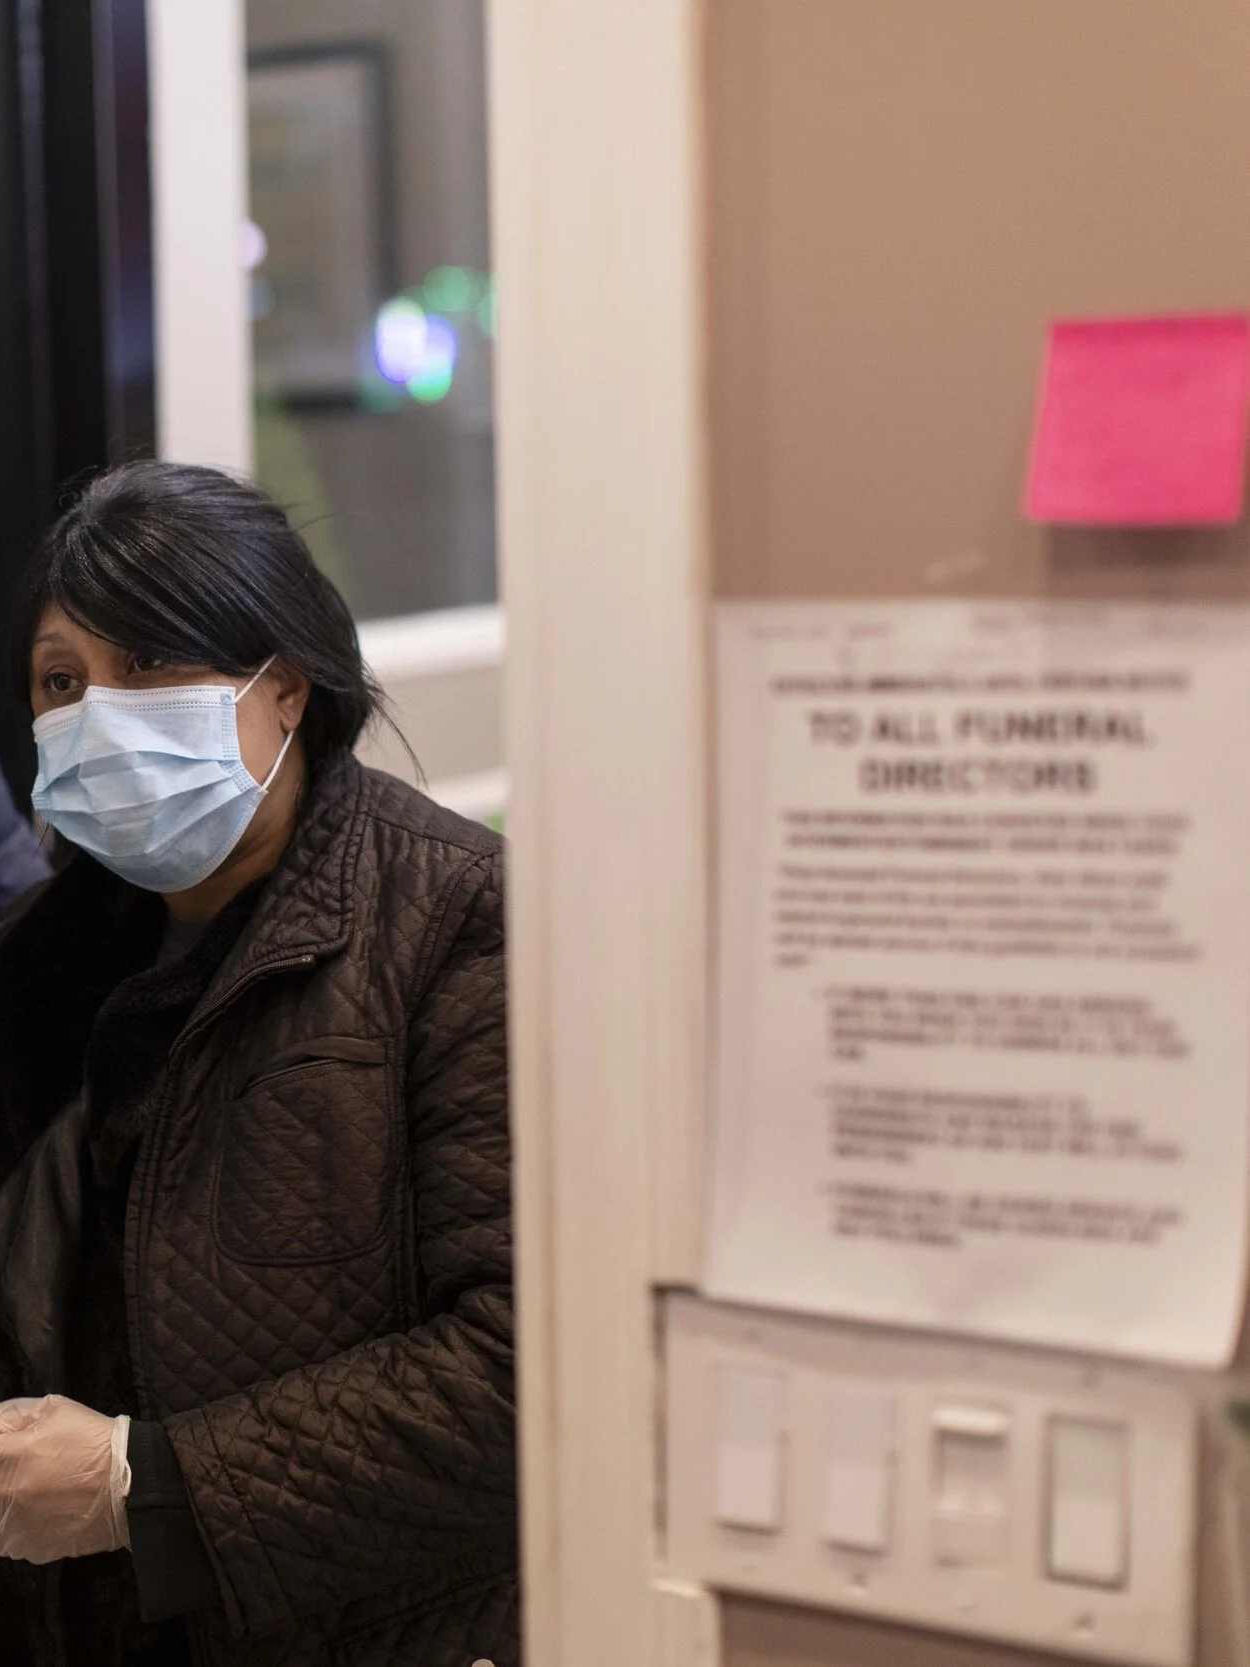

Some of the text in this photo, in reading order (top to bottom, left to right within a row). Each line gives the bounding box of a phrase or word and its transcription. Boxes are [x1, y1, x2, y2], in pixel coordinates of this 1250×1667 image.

[807, 711, 1153, 748] TO ALL FUNERAL
[859, 760, 1097, 794] DIRECTORS
